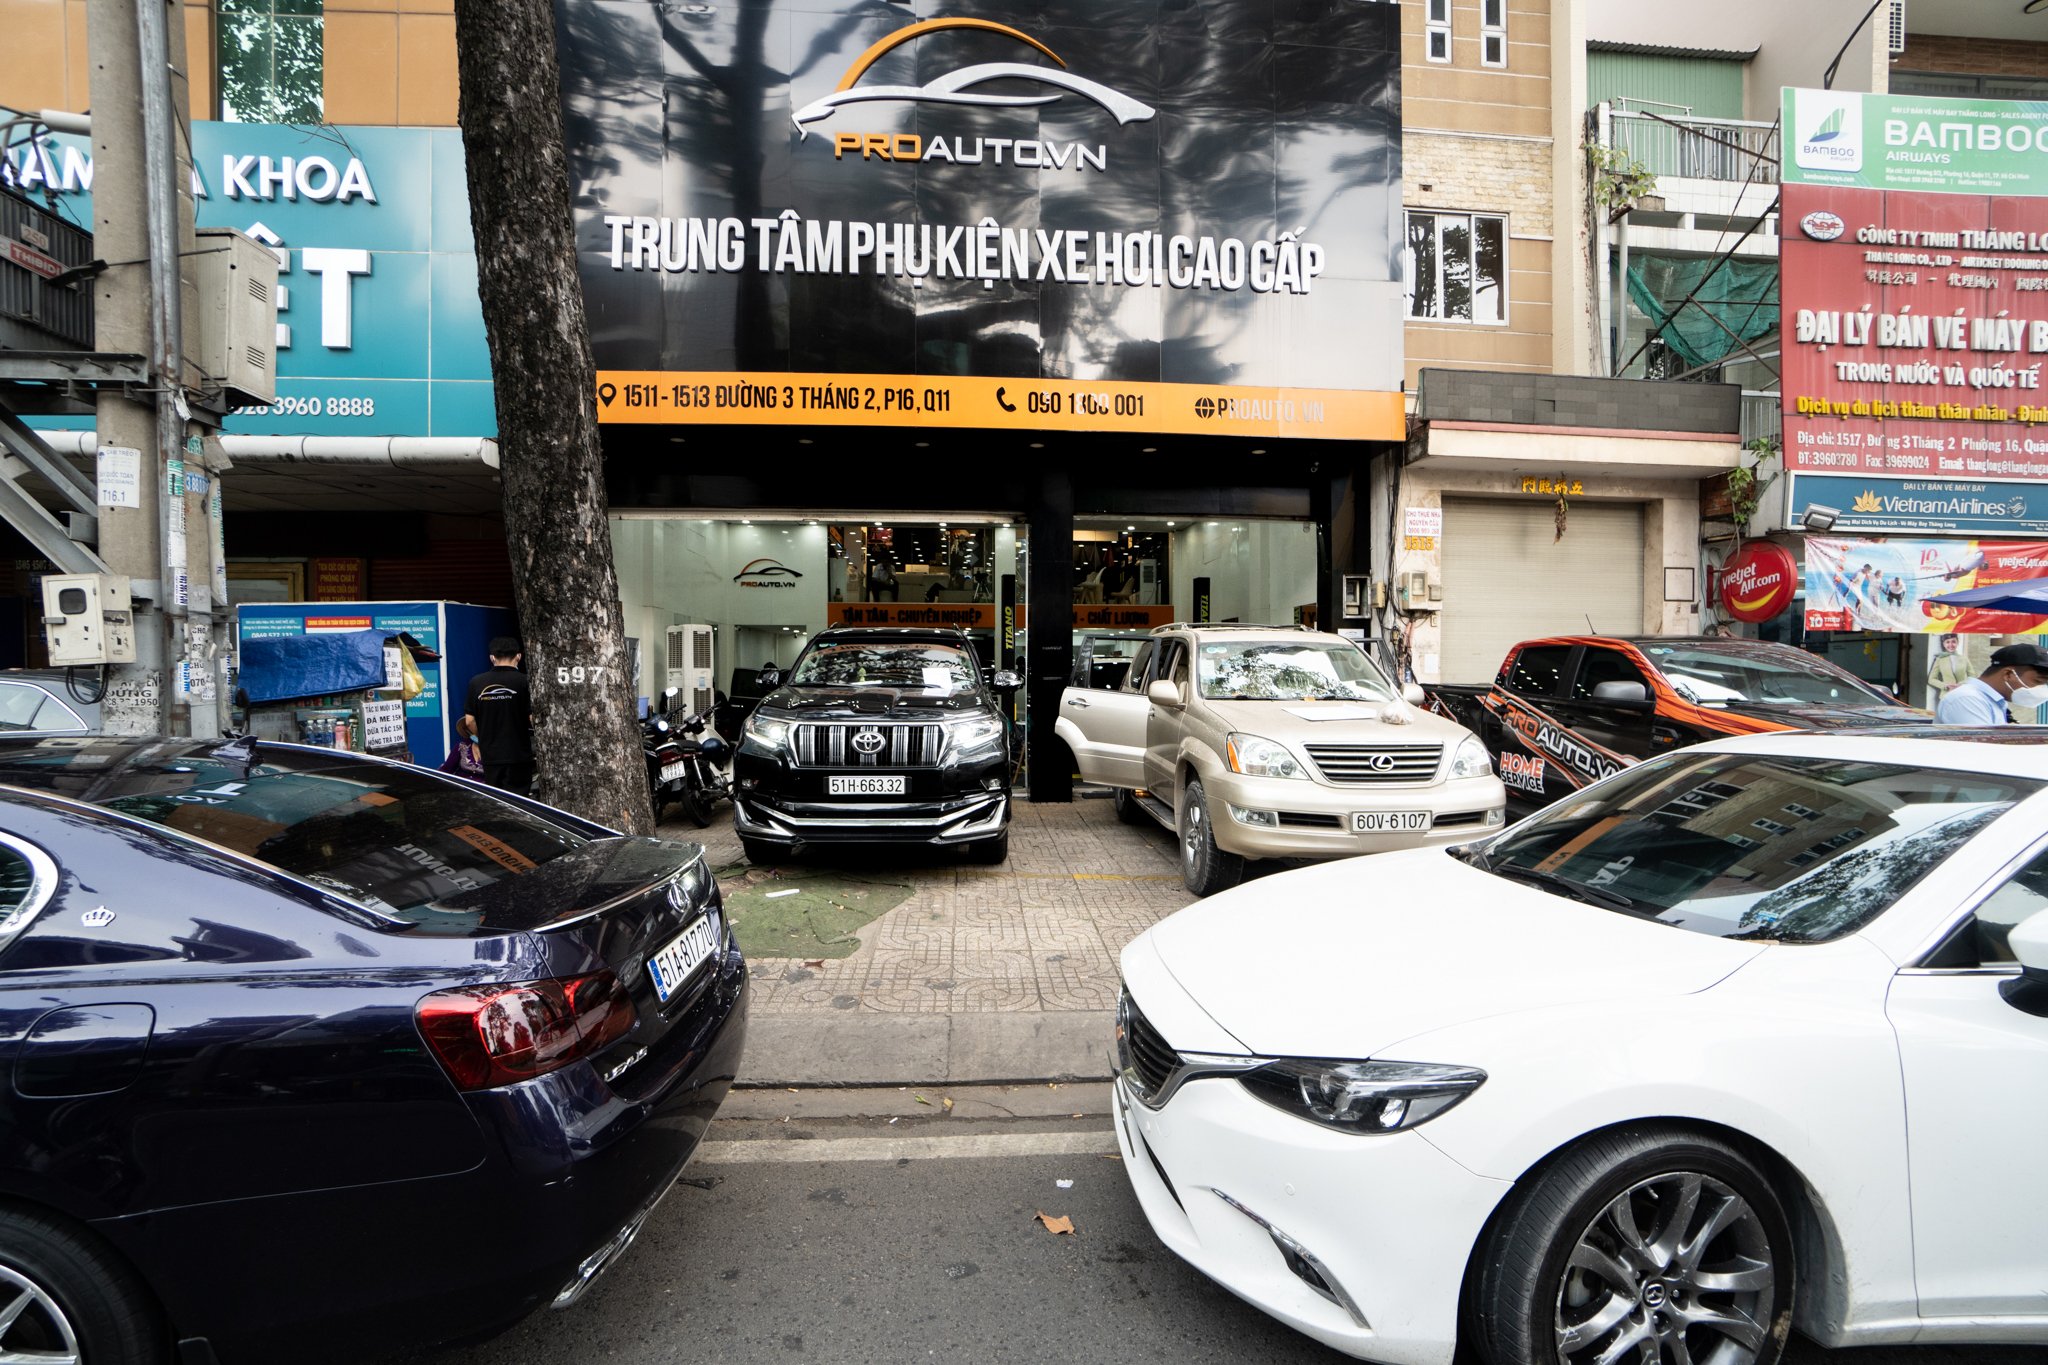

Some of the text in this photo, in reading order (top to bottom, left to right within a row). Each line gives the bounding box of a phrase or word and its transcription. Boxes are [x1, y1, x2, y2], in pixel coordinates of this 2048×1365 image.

[834, 132, 1106, 172] PROAUTO.VN
[1803, 145, 1854, 157] BAMBOO
[1886, 151, 1951, 164] AIRWAYS
[223, 154, 378, 205] KHOA
[1857, 224, 1897, 244] CÔNG
[1900, 230, 1918, 246] TY
[1921, 231, 1958, 248] TNHH
[1961, 227, 2025, 251] THĂNG
[604, 209, 1325, 295] TRUNG TÂM PHỤ KIỆN XE HƠI CAO CẤP
[1865, 250, 1893, 263] THANG
[1894, 252, 1916, 264] LONG
[1960, 255, 2003, 269] AIRTICKET
[2004, 257, 2041, 270] BOOKING
[1796, 309, 1840, 351] ĐẠI
[1843, 303, 1873, 346] LÝ
[1877, 304, 1929, 347] BÁN
[1933, 307, 1967, 349] VÉ
[1970, 309, 2027, 351] MÁY
[1835, 359, 2043, 389] TRONG NƯỚC VÀ QUỐC TẾ
[273, 396, 321, 416] 3960
[325, 397, 375, 416] 8888
[624, 383, 658, 408] 1511
[672, 384, 710, 408] 1513
[715, 380, 777, 409] ĐƯỜNG
[782, 386, 794, 409] 3
[799, 382, 859, 410] THÁNG
[923, 388, 951, 412] Q11
[1028, 391, 1061, 414] 090
[1068, 392, 1110, 415] 1800
[1114, 393, 1144, 416] 001
[1796, 396, 1830, 420] Dịch
[1832, 402, 1850, 421] vụ
[1852, 399, 1870, 415] du
[1871, 400, 1899, 422] lịch
[1938, 402, 1971, 420] thân
[1972, 403, 2008, 421] nhân
[1797, 430, 1815, 447] Địa
[1816, 431, 1834, 445] chỉ:
[1837, 432, 1865, 448] 1517,
[1902, 435, 1911, 448] 3
[1911, 435, 1944, 451] Tháng
[1947, 437, 1955, 450] 2
[1961, 438, 2002, 452] Phường
[2005, 439, 2022, 453] 16,
[1866, 454, 1883, 468] Fax:
[1885, 455, 1929, 469] 39699024
[1939, 456, 1964, 470] Email:
[103, 489, 126, 502] T16.1
[1903, 481, 1986, 492] ĐẠI LÝ BÁN VÉ MÁY BAY
[1404, 536, 1434, 550] 1515
[740, 580, 795, 588] PROAUTO.VN
[842, 607, 982, 626] TẬN TÂM CHUYÊN NGHIỆP
[1088, 610, 1149, 626] CHẤT LƯỢNG
[1201, 595, 1209, 625] TITAN
[557, 665, 604, 686] 597
[391, 703, 401, 711] 15K
[393, 724, 402, 732] 15K
[394, 735, 403, 743] 10K
[1501, 751, 1544, 778] HOME
[1501, 771, 1543, 791] SERVICE
[1357, 813, 1426, 829] 60V-6107
[658, 920, 713, 988] 51A-817.70
[604, 1045, 648, 1083] LEXUS
